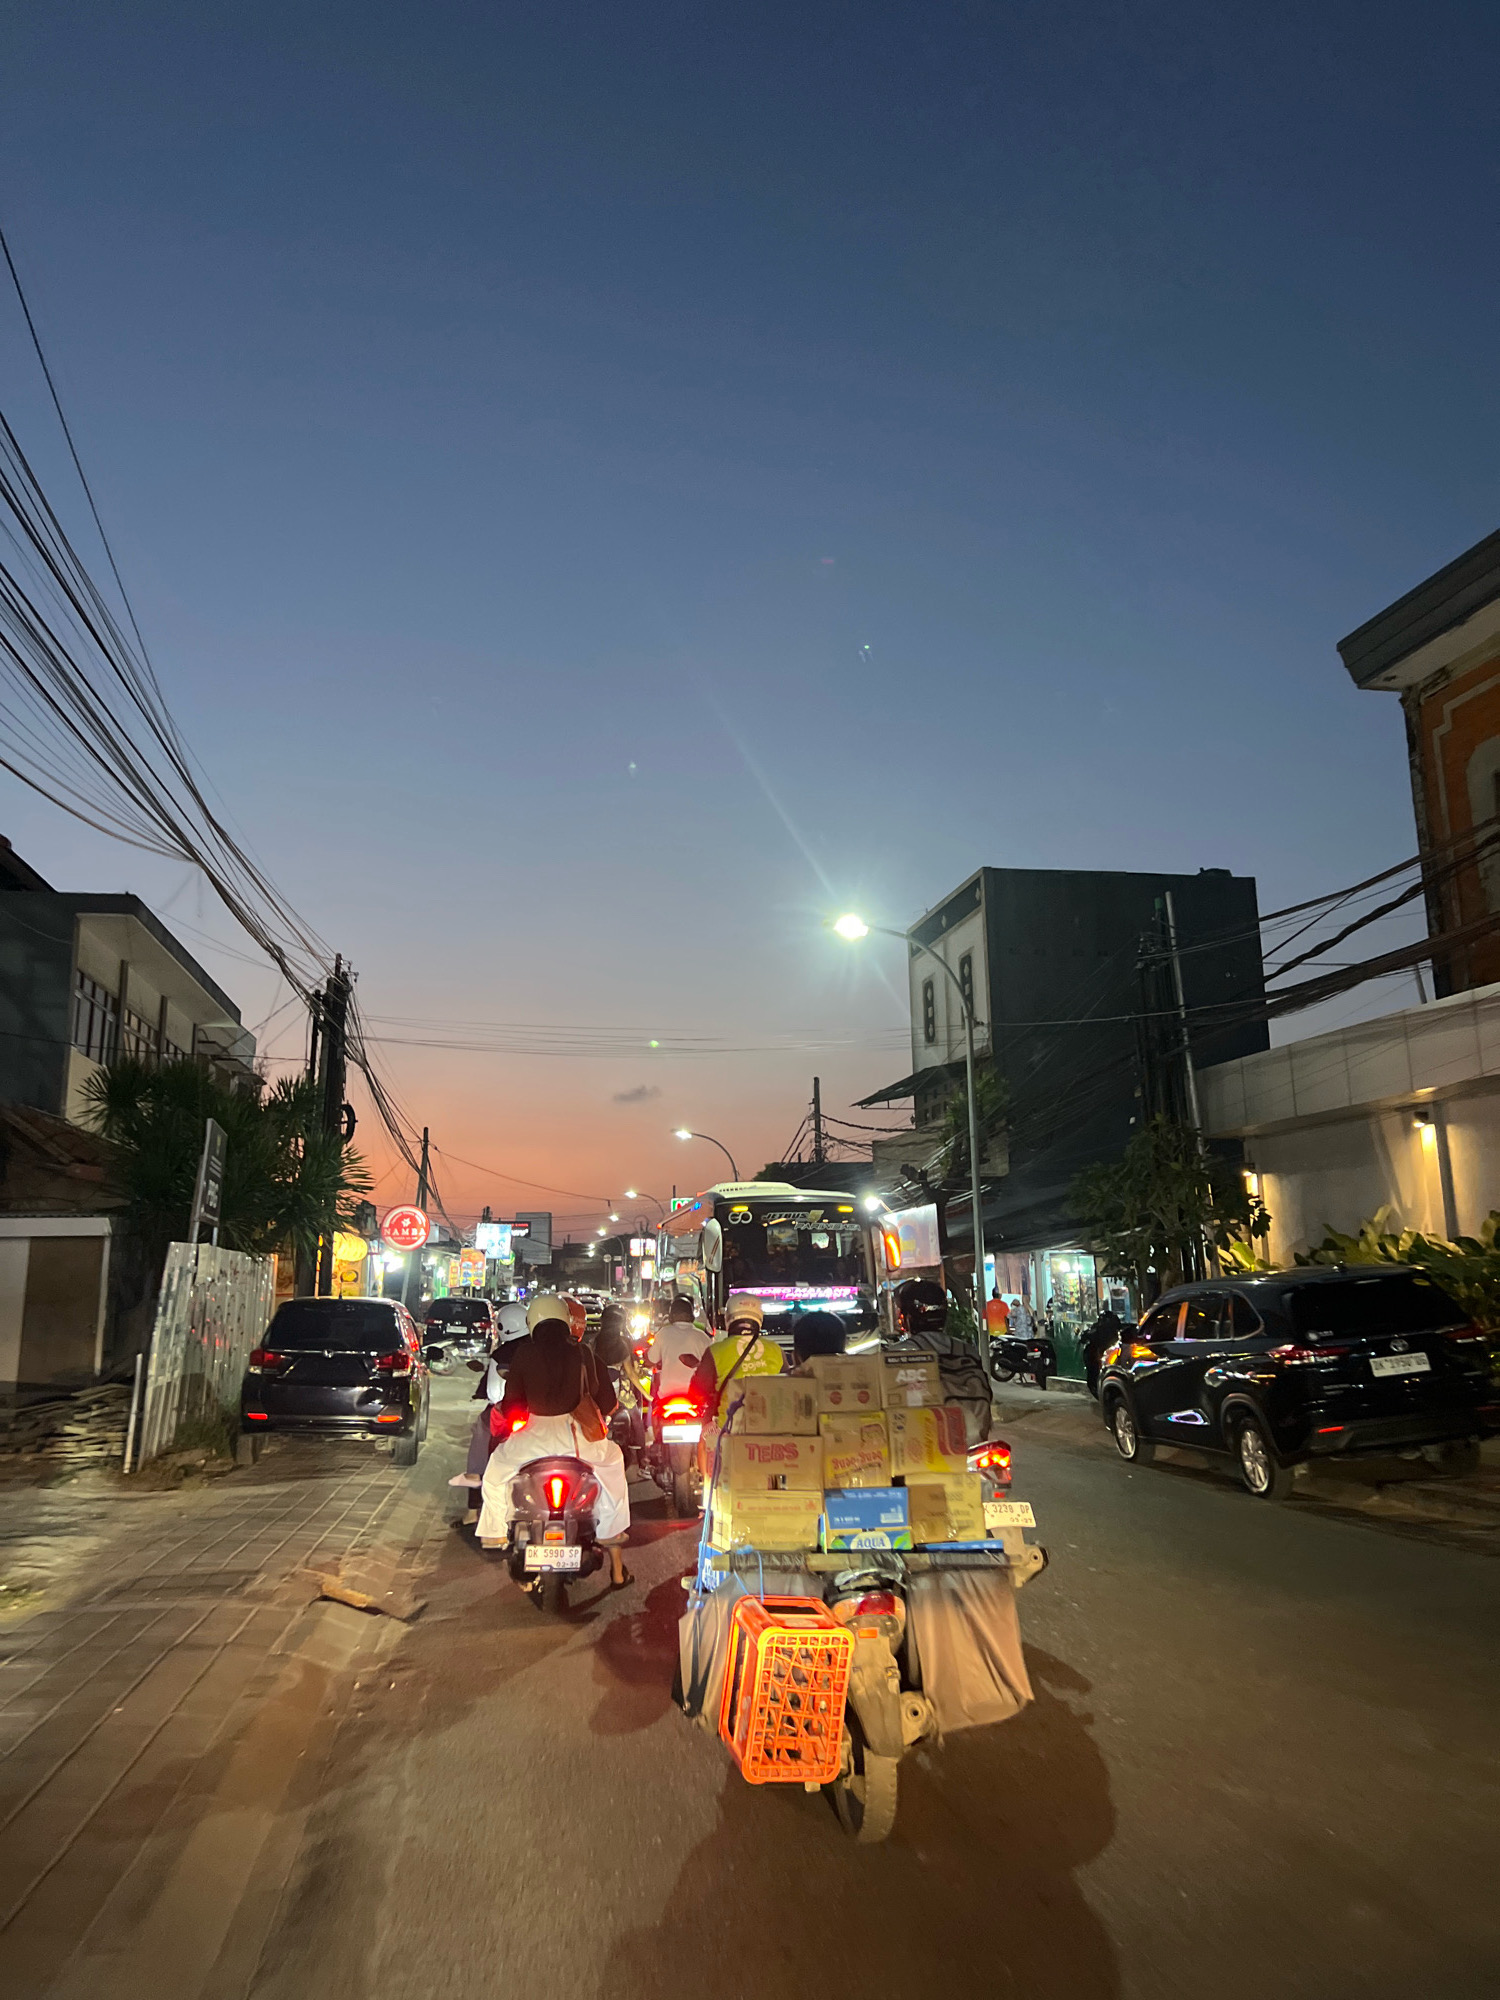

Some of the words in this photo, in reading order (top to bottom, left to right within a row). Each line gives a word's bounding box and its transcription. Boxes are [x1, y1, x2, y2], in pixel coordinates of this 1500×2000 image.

[383, 1228, 427, 1236] NAMBA
[742, 1359, 767, 1372] gojek
[896, 1368, 927, 1382] ABC
[745, 1442, 799, 1463] TEBS
[856, 1537, 886, 1549] AQUA
[528, 1549, 538, 1558] DK
[543, 1549, 565, 1558] 5990
[569, 1549, 579, 1558] SP
